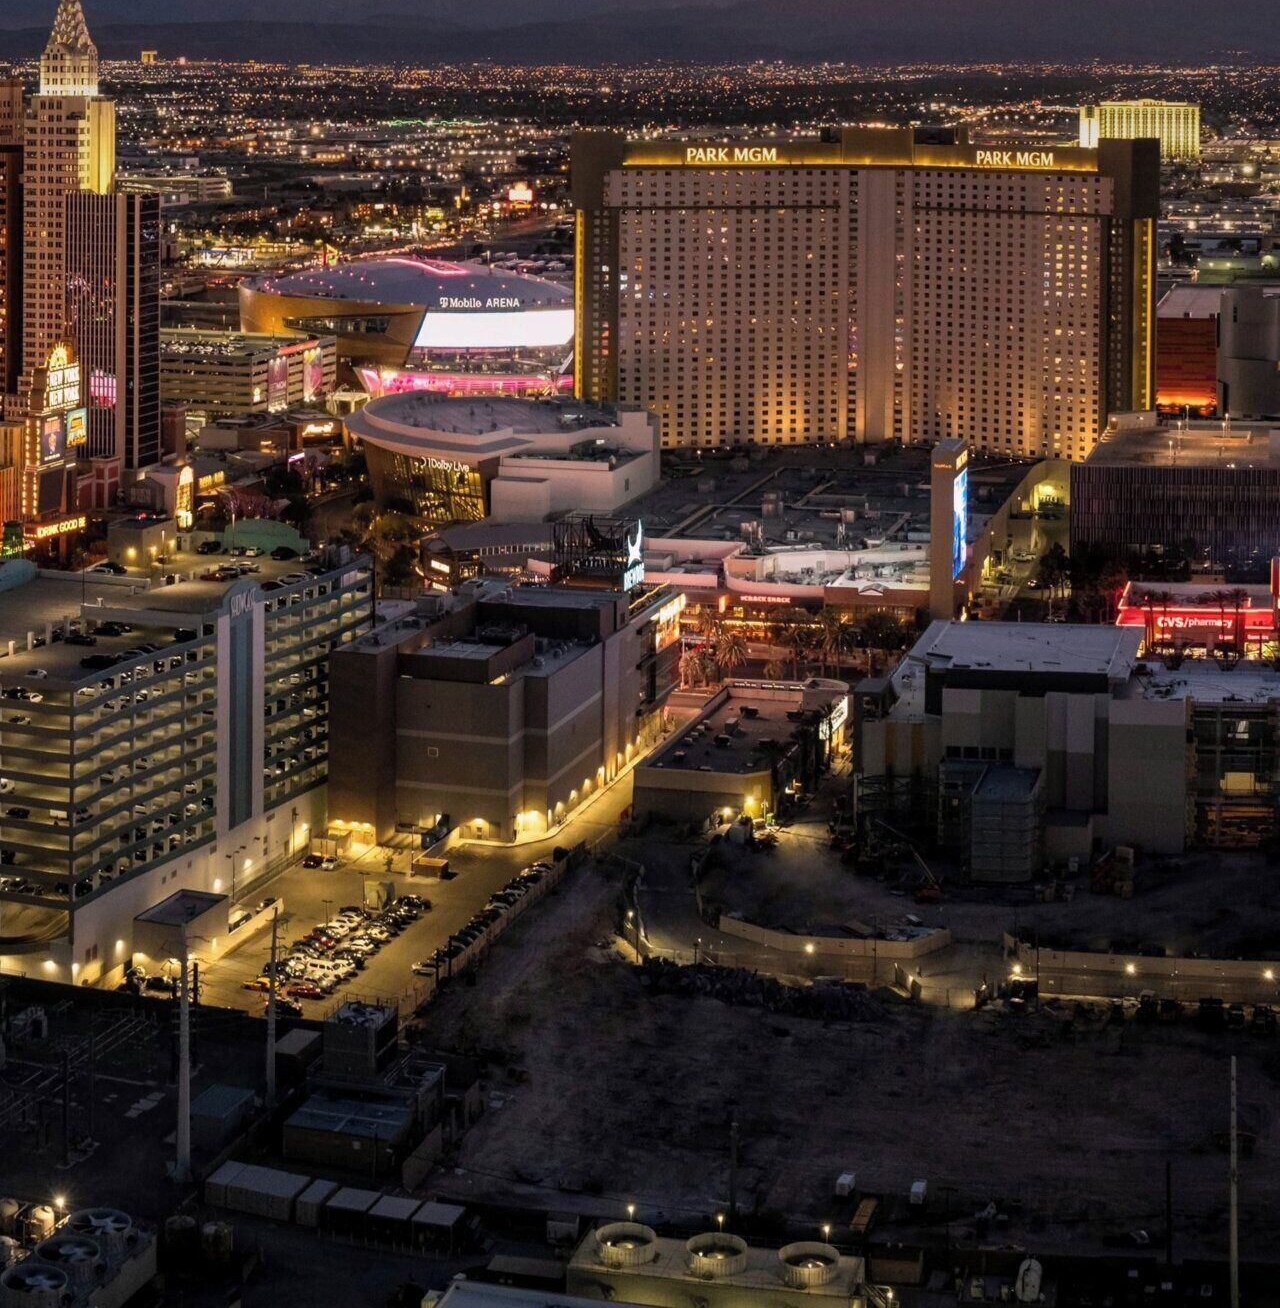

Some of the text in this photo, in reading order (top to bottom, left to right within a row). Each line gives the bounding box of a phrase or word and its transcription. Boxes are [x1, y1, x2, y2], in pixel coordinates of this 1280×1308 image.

[686, 147, 777, 162] PARK MGM
[976, 151, 1054, 167] PARK MGM
[485, 297, 520, 308] ARENA
[431, 457, 470, 473] Dolby Live
[59, 519, 78, 533] GOOD
